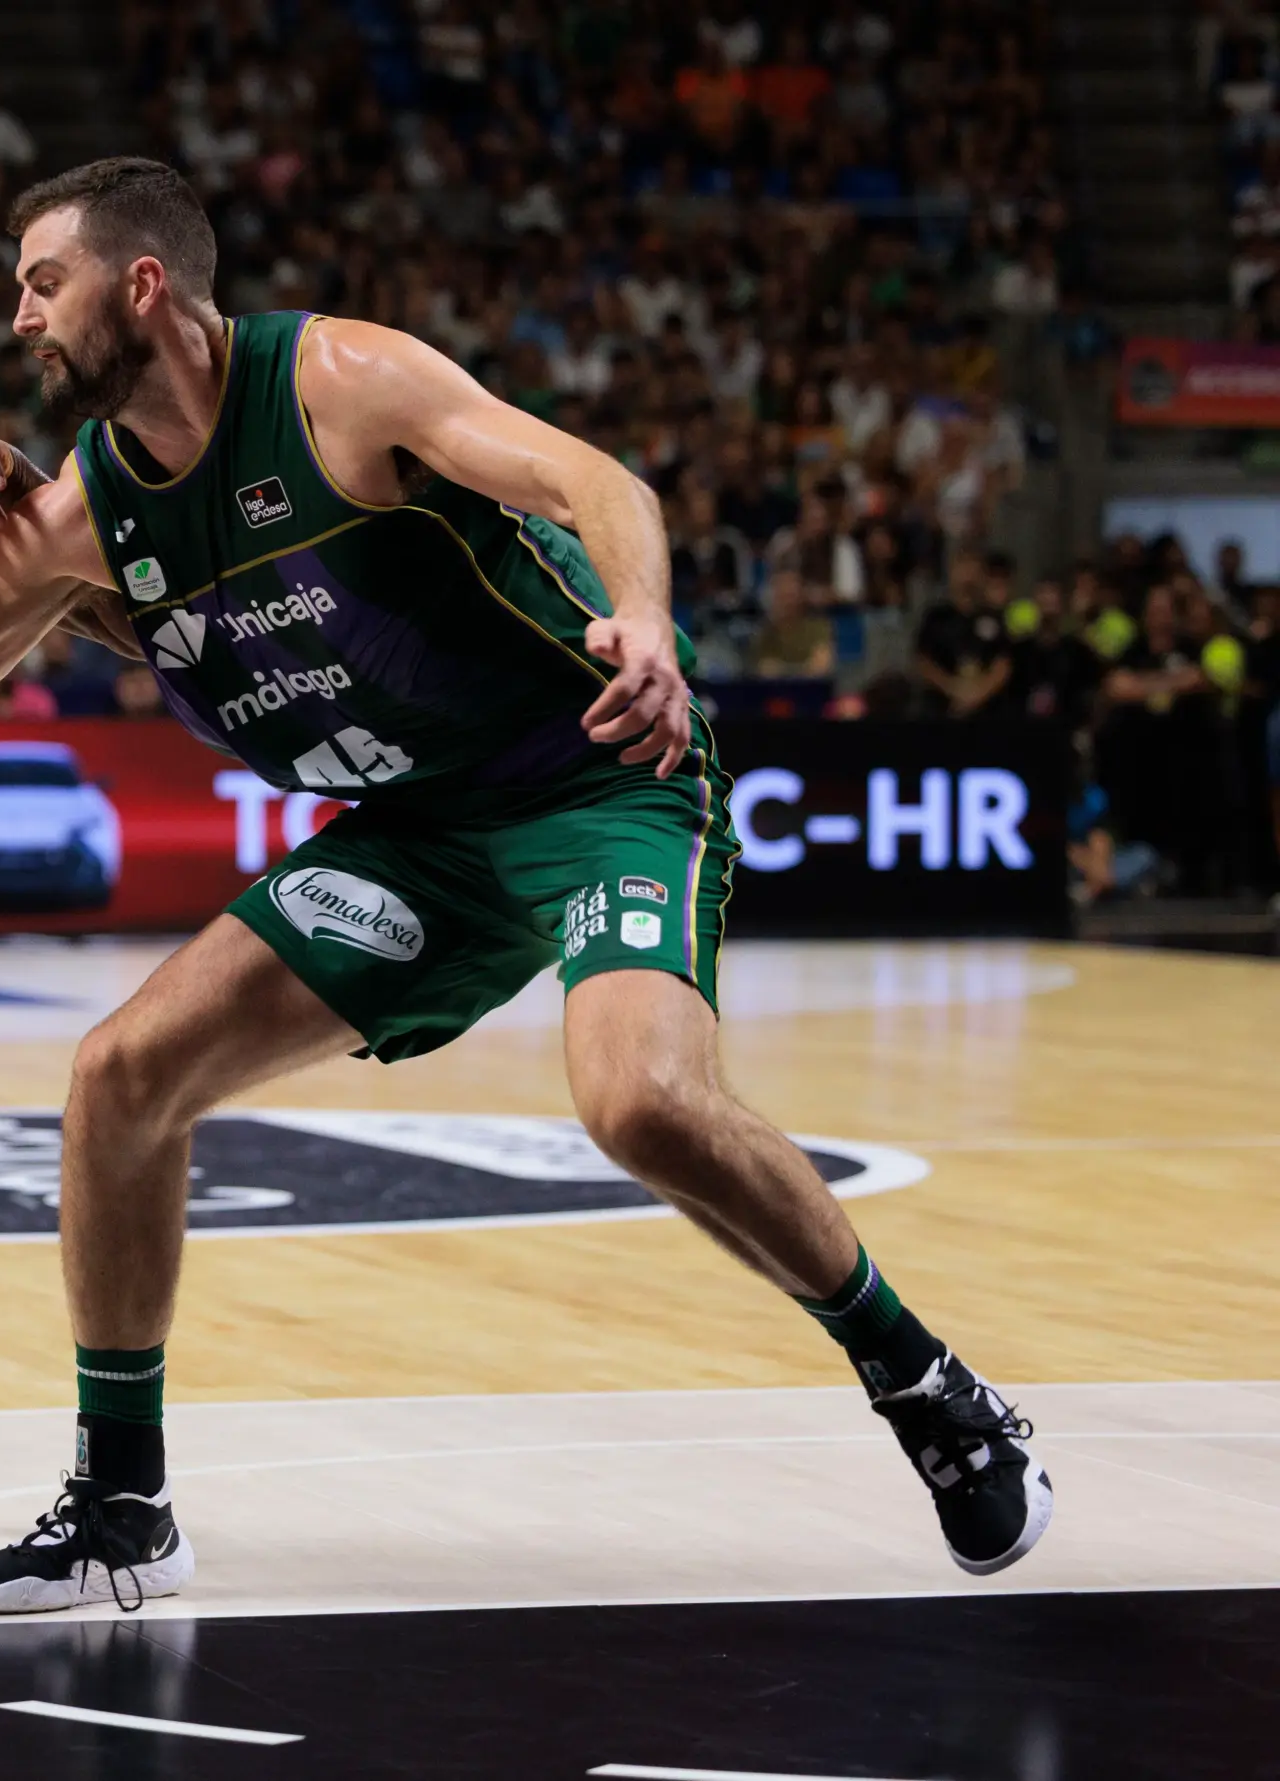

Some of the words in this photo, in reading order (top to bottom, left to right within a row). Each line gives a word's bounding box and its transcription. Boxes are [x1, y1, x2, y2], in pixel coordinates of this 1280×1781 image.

[245, 498, 265, 513] liga
[251, 501, 288, 522] endesa
[729, 766, 1035, 872] C-HR
[624, 882, 658, 898] acb
[279, 870, 420, 950] famadesa
